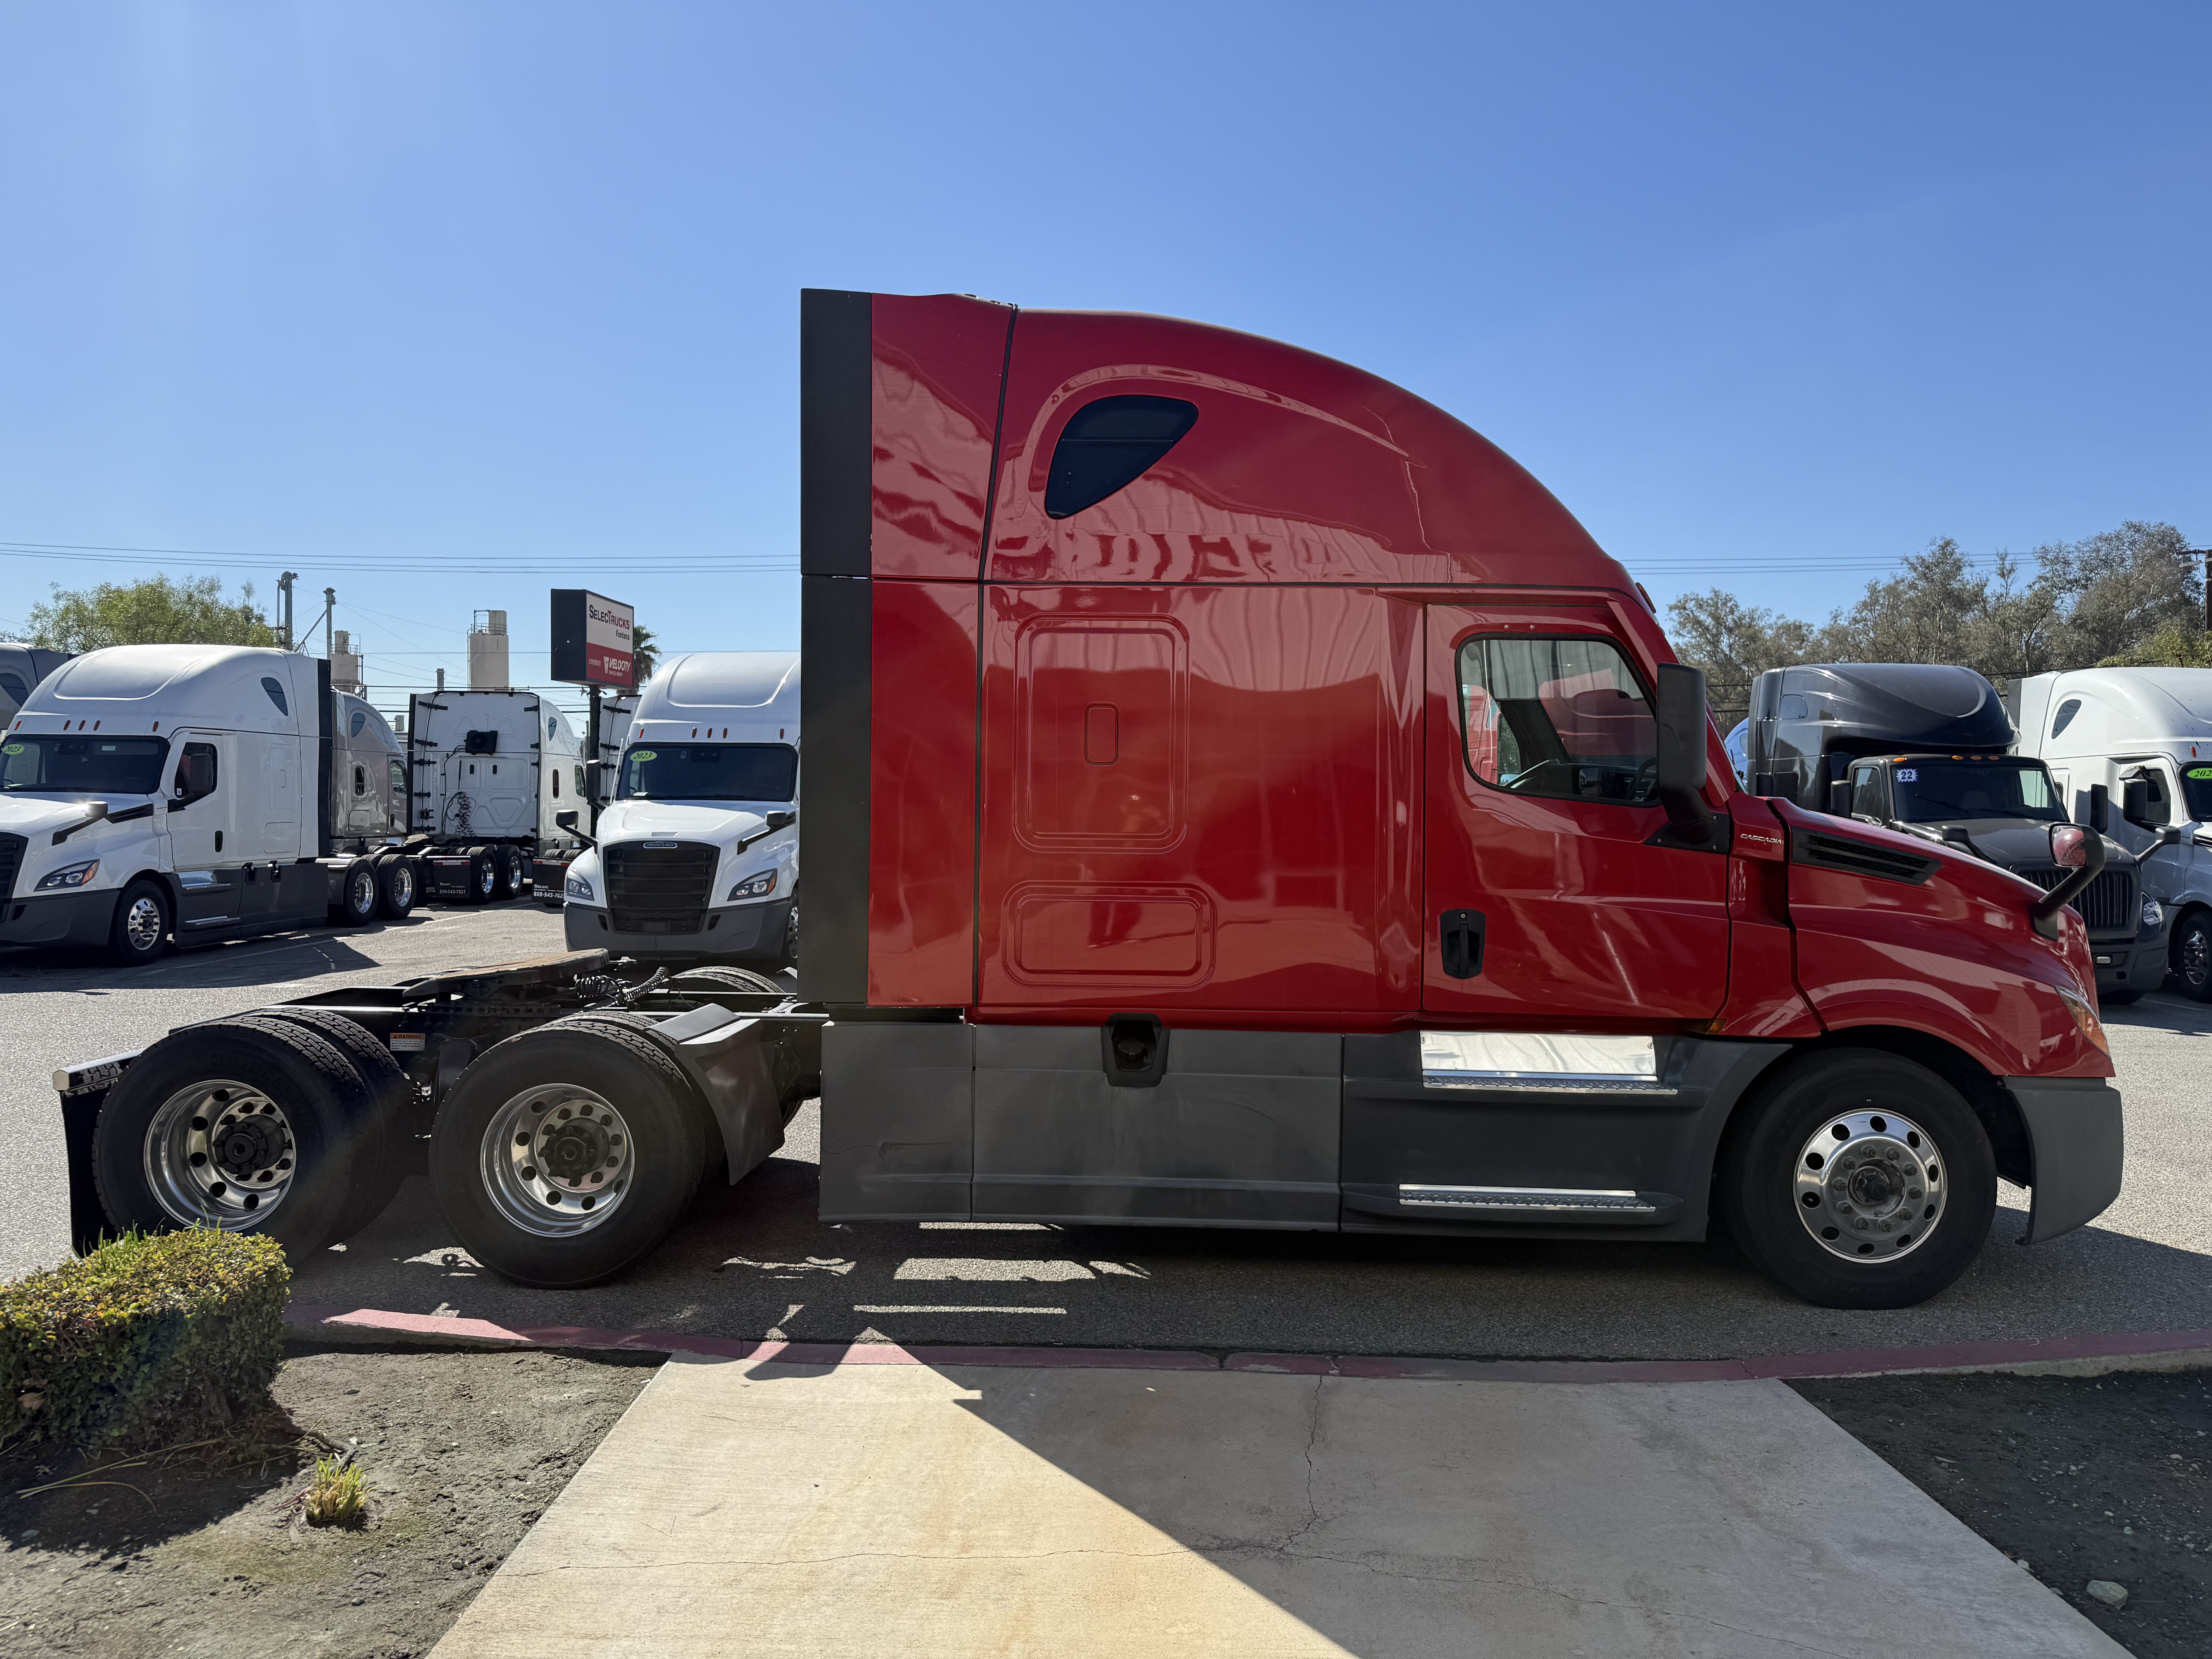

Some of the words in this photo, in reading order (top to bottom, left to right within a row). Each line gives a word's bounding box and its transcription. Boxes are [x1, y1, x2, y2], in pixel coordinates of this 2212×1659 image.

[589, 604, 630, 630] SELECTRUCKS
[616, 630, 630, 640] Fontana
[609, 657, 631, 672] VELOCITY
[1901, 771, 1912, 780] 22
[1740, 833, 1781, 844] CASCADIA
